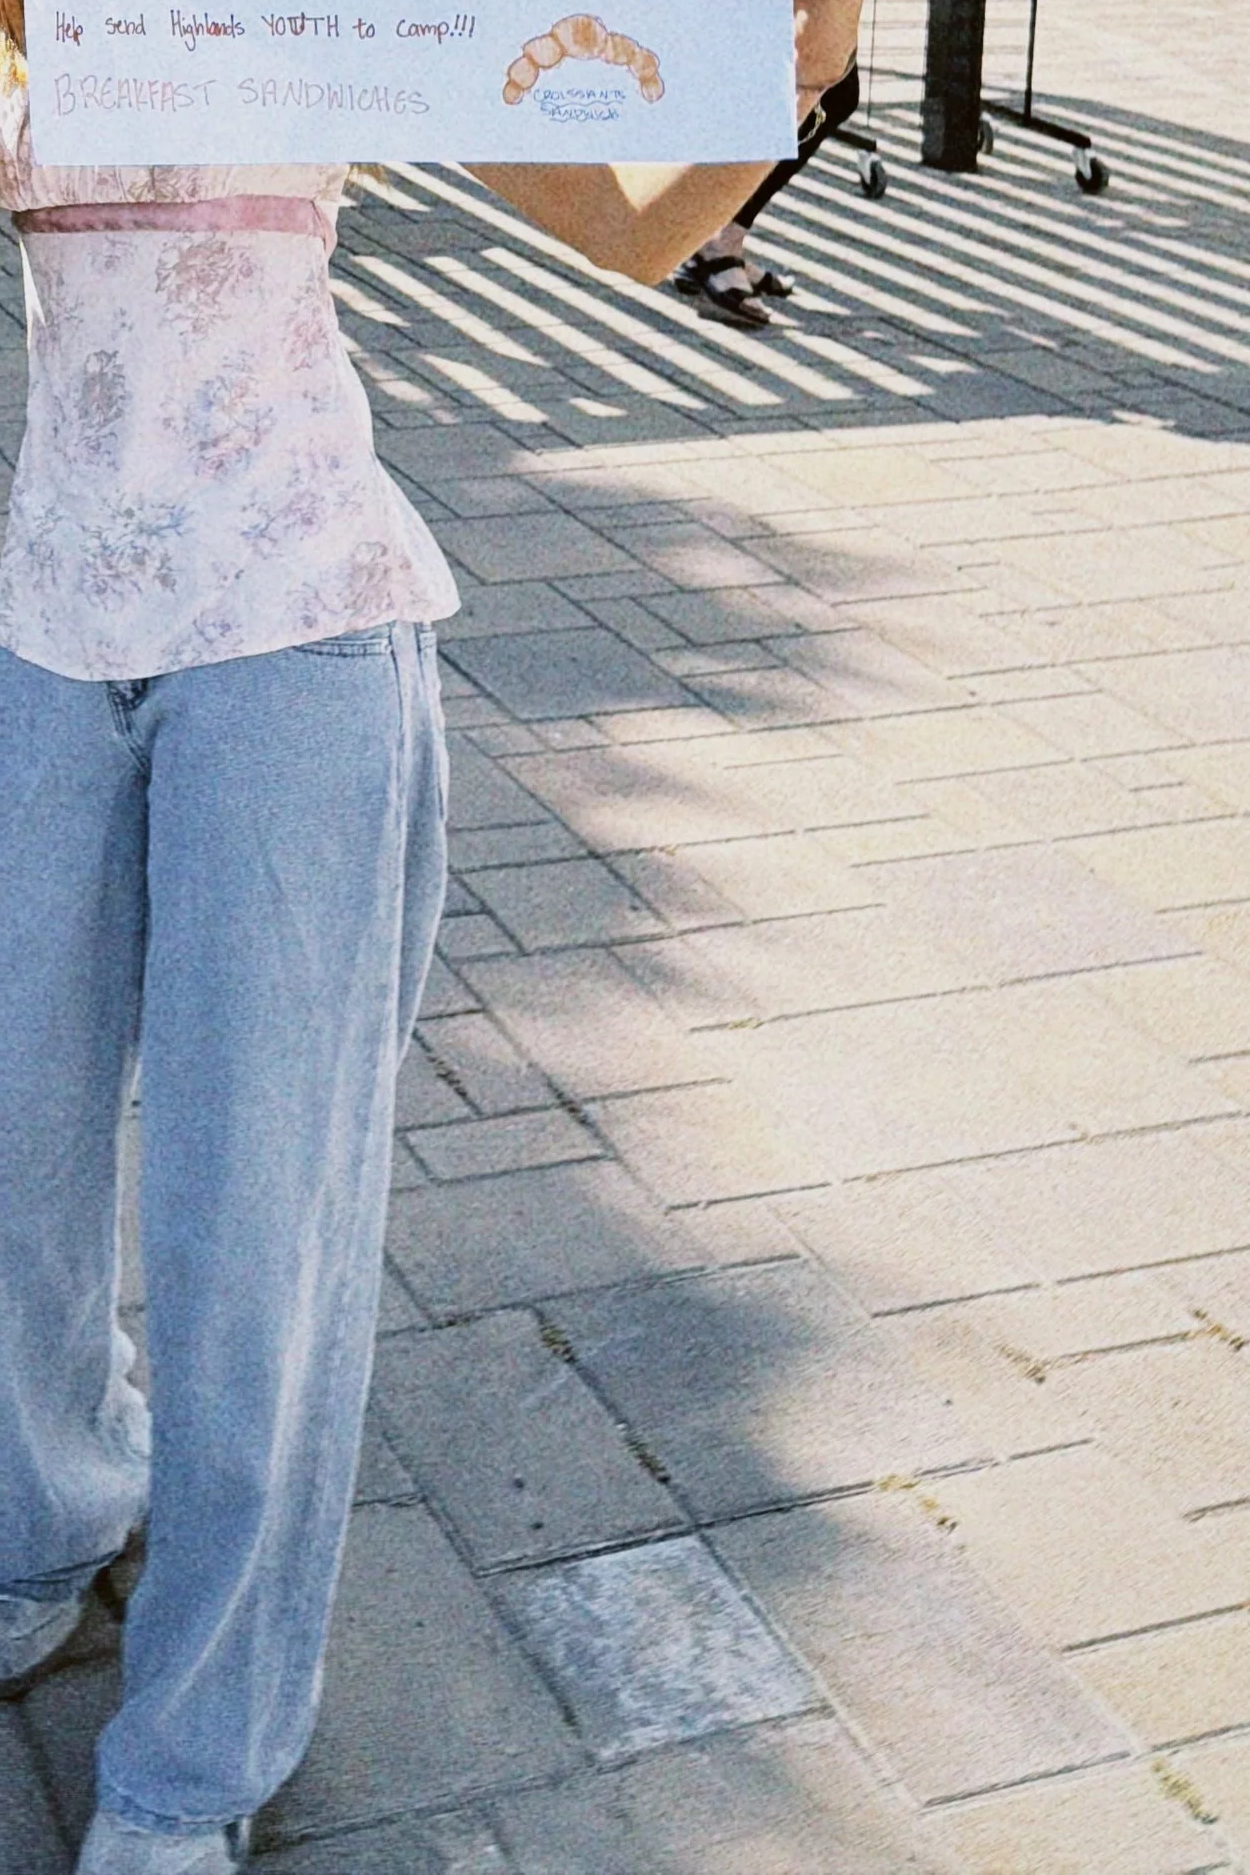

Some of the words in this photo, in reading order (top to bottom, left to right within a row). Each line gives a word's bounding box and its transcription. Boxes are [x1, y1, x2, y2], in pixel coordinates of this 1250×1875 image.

[56, 11, 84, 46] Help
[170, 9, 246, 51] Highlands
[260, 12, 340, 37] YOUTH
[352, 18, 376, 39] to
[54, 73, 216, 116] BREAKFAST
[238, 78, 430, 114] SANDWICHES
